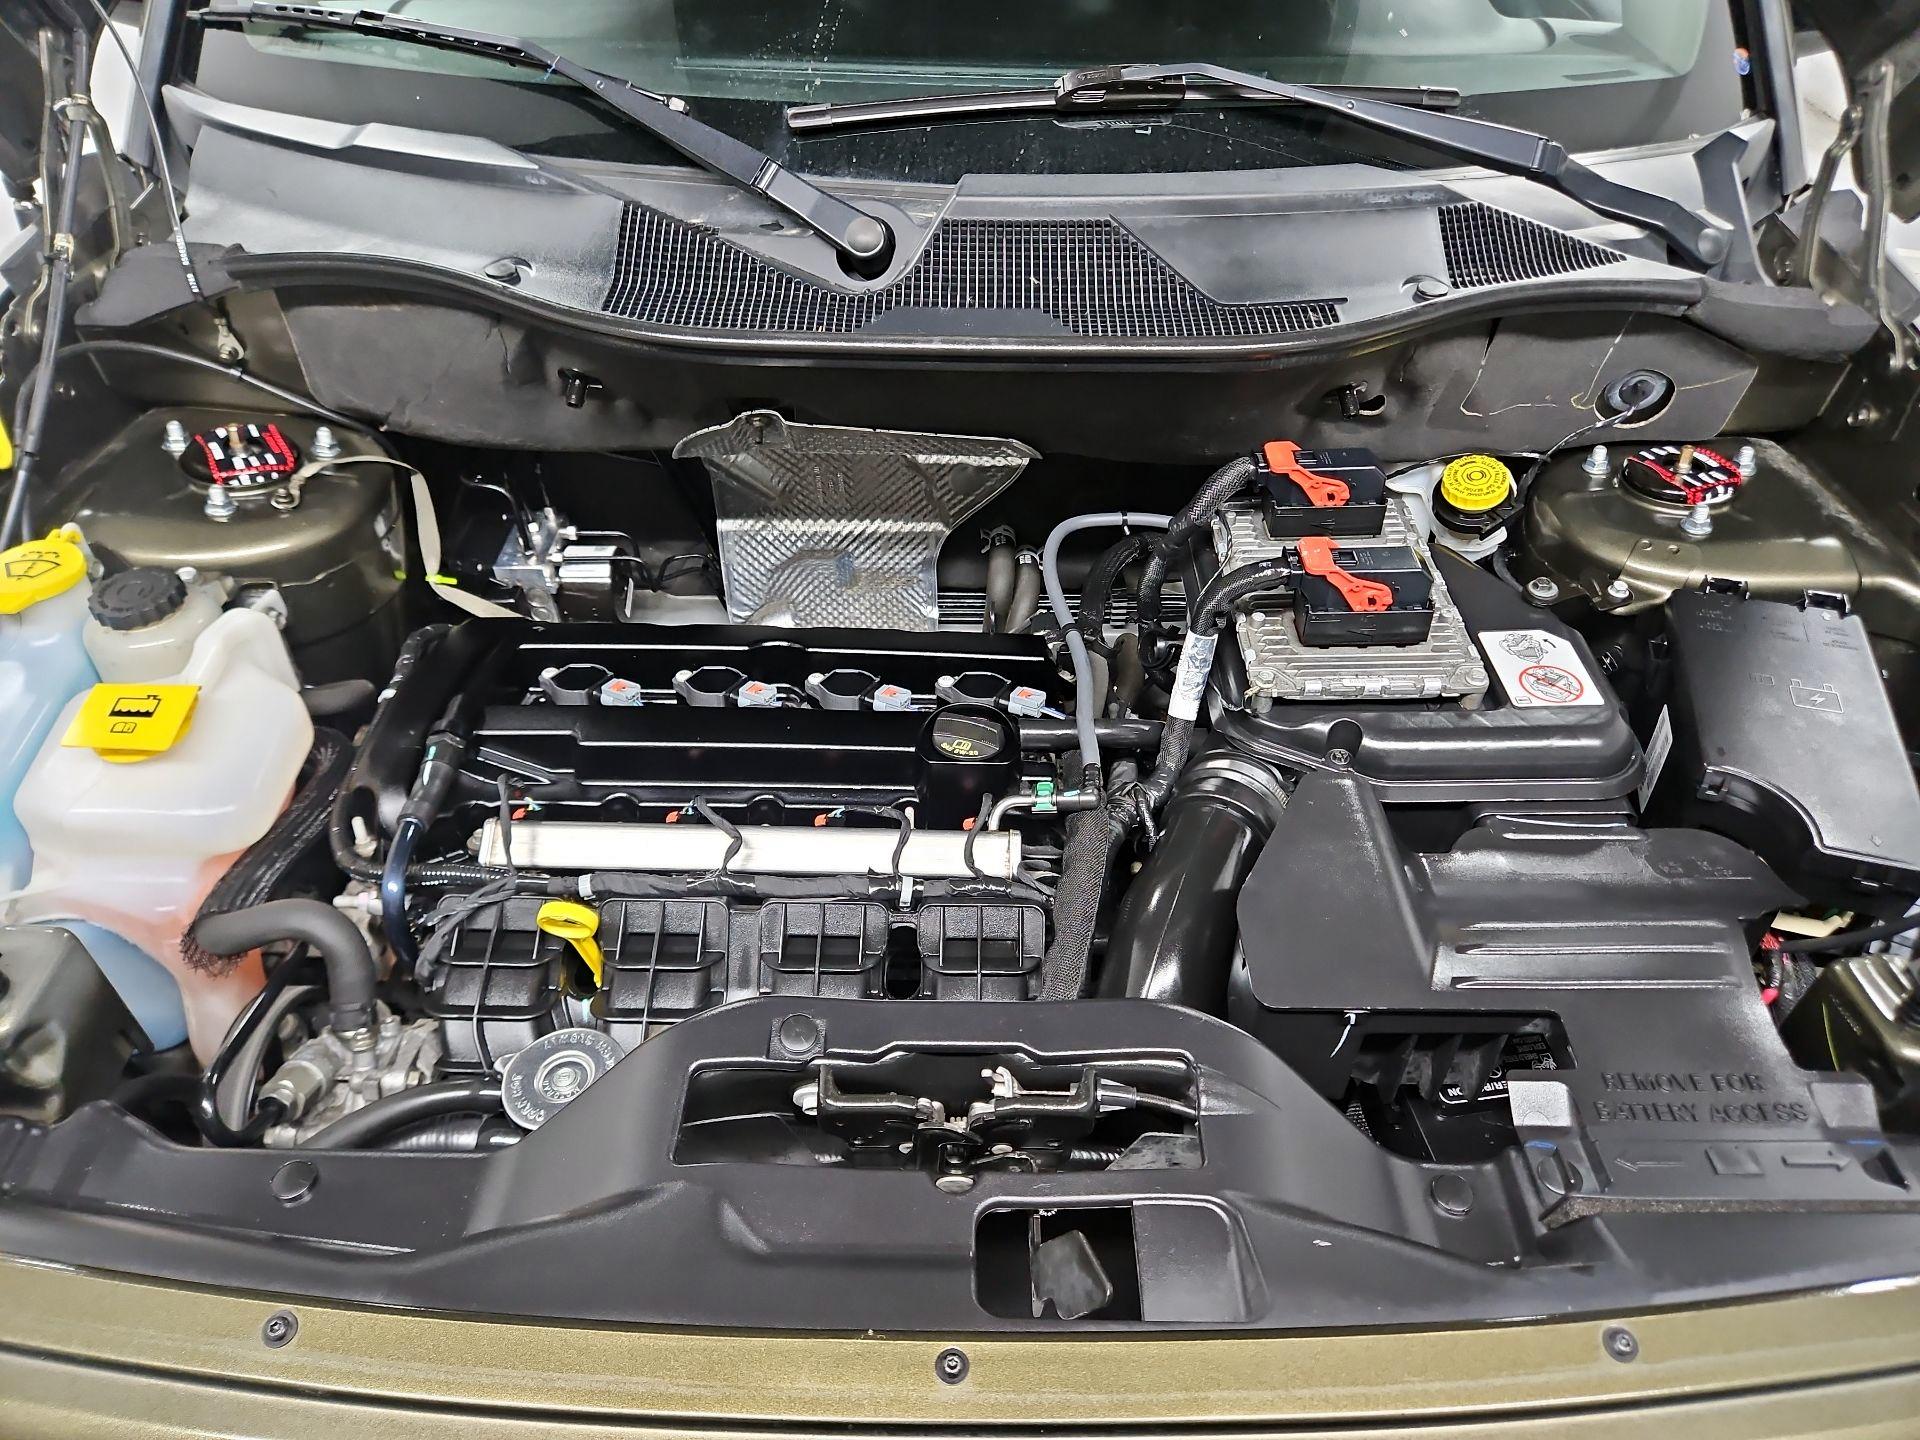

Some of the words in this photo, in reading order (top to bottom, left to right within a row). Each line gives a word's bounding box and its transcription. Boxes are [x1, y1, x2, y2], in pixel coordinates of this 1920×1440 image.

[1600, 1071, 1708, 1093] REMOVE
[1710, 1072, 1768, 1094] FOR
[1593, 1100, 1700, 1123] BATTERY
[1710, 1102, 1810, 1124] ACCESS
